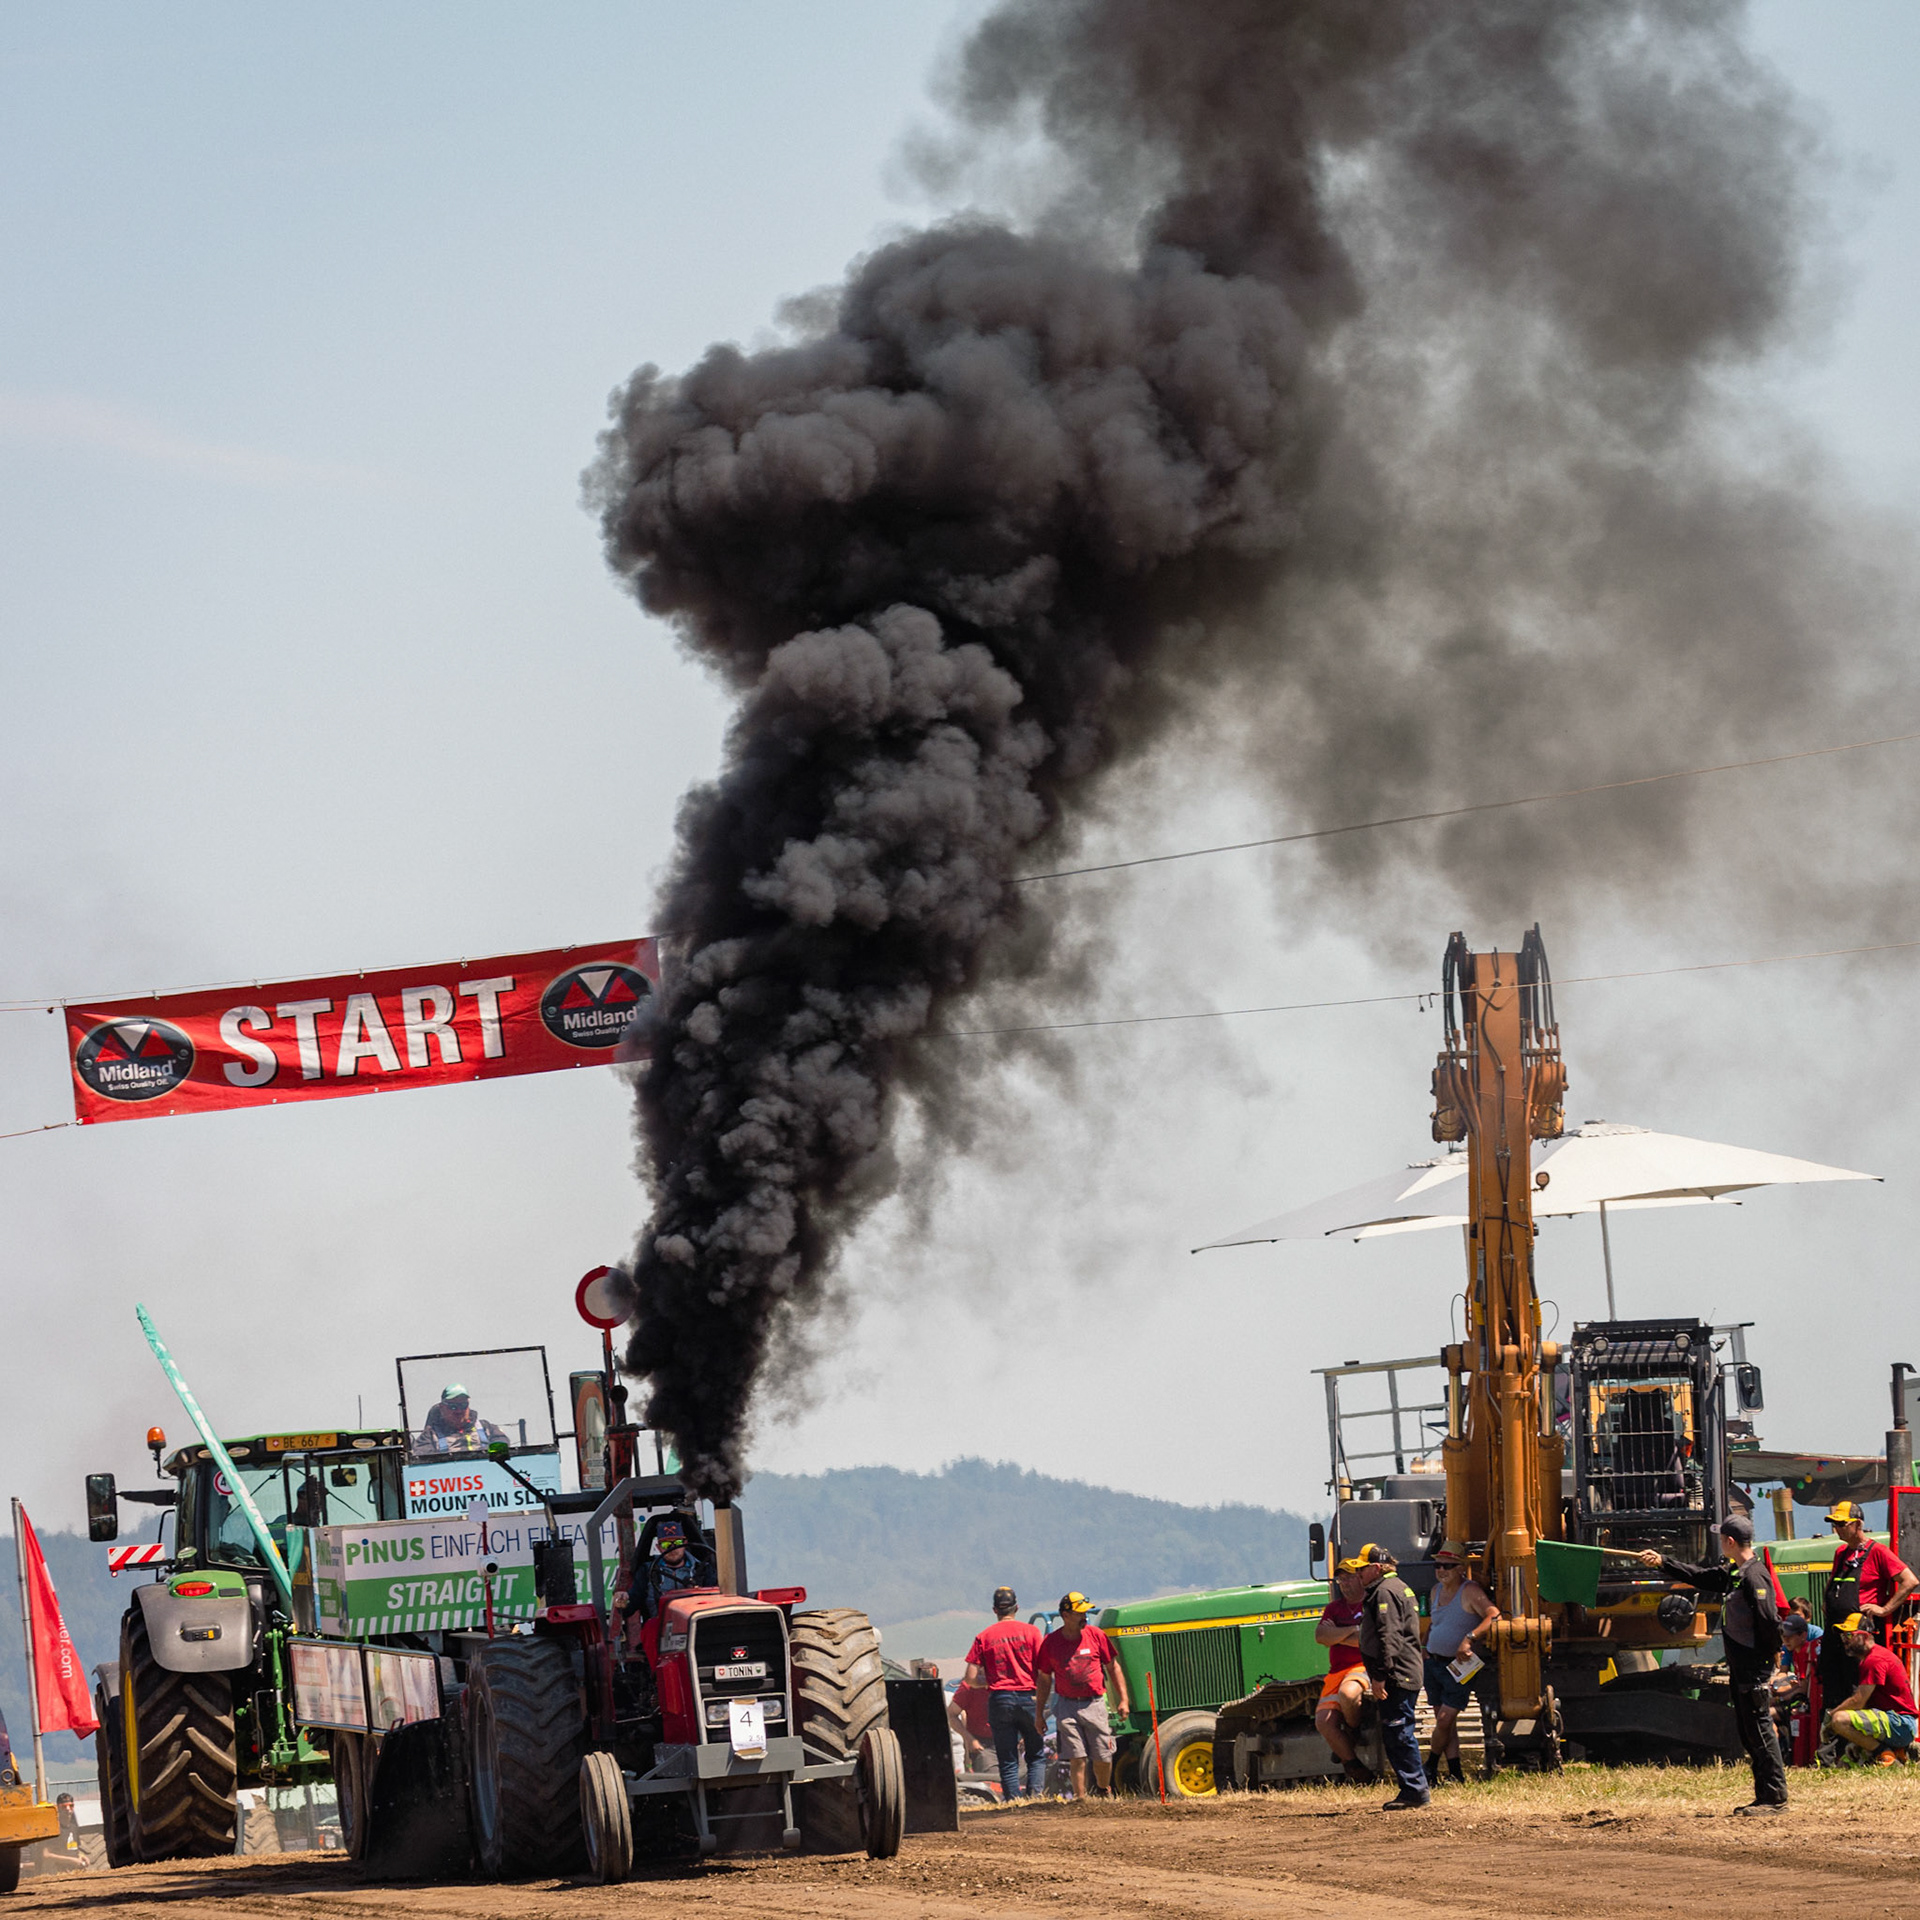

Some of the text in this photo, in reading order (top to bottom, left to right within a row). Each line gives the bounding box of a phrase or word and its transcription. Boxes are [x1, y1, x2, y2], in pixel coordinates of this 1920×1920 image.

[563, 1006, 637, 1030] Midland
[219, 976, 515, 1087] START
[572, 1030, 594, 1038] Swiss
[594, 1026, 620, 1035] Quality
[98, 1060, 174, 1083] Midland
[108, 1083, 130, 1091] Swiss
[130, 1081, 155, 1089] Quality
[283, 1435, 320, 1449] BE 667
[429, 1475, 484, 1495] SWISS
[431, 1528, 520, 1559] EINFACH
[528, 1521, 615, 1550] EIFAH
[387, 1574, 519, 1610] STRAIGHT
[1256, 1608, 1324, 1621] JOHN DEER
[728, 1666, 753, 1677] TONIN
[740, 1710, 753, 1727] 4
